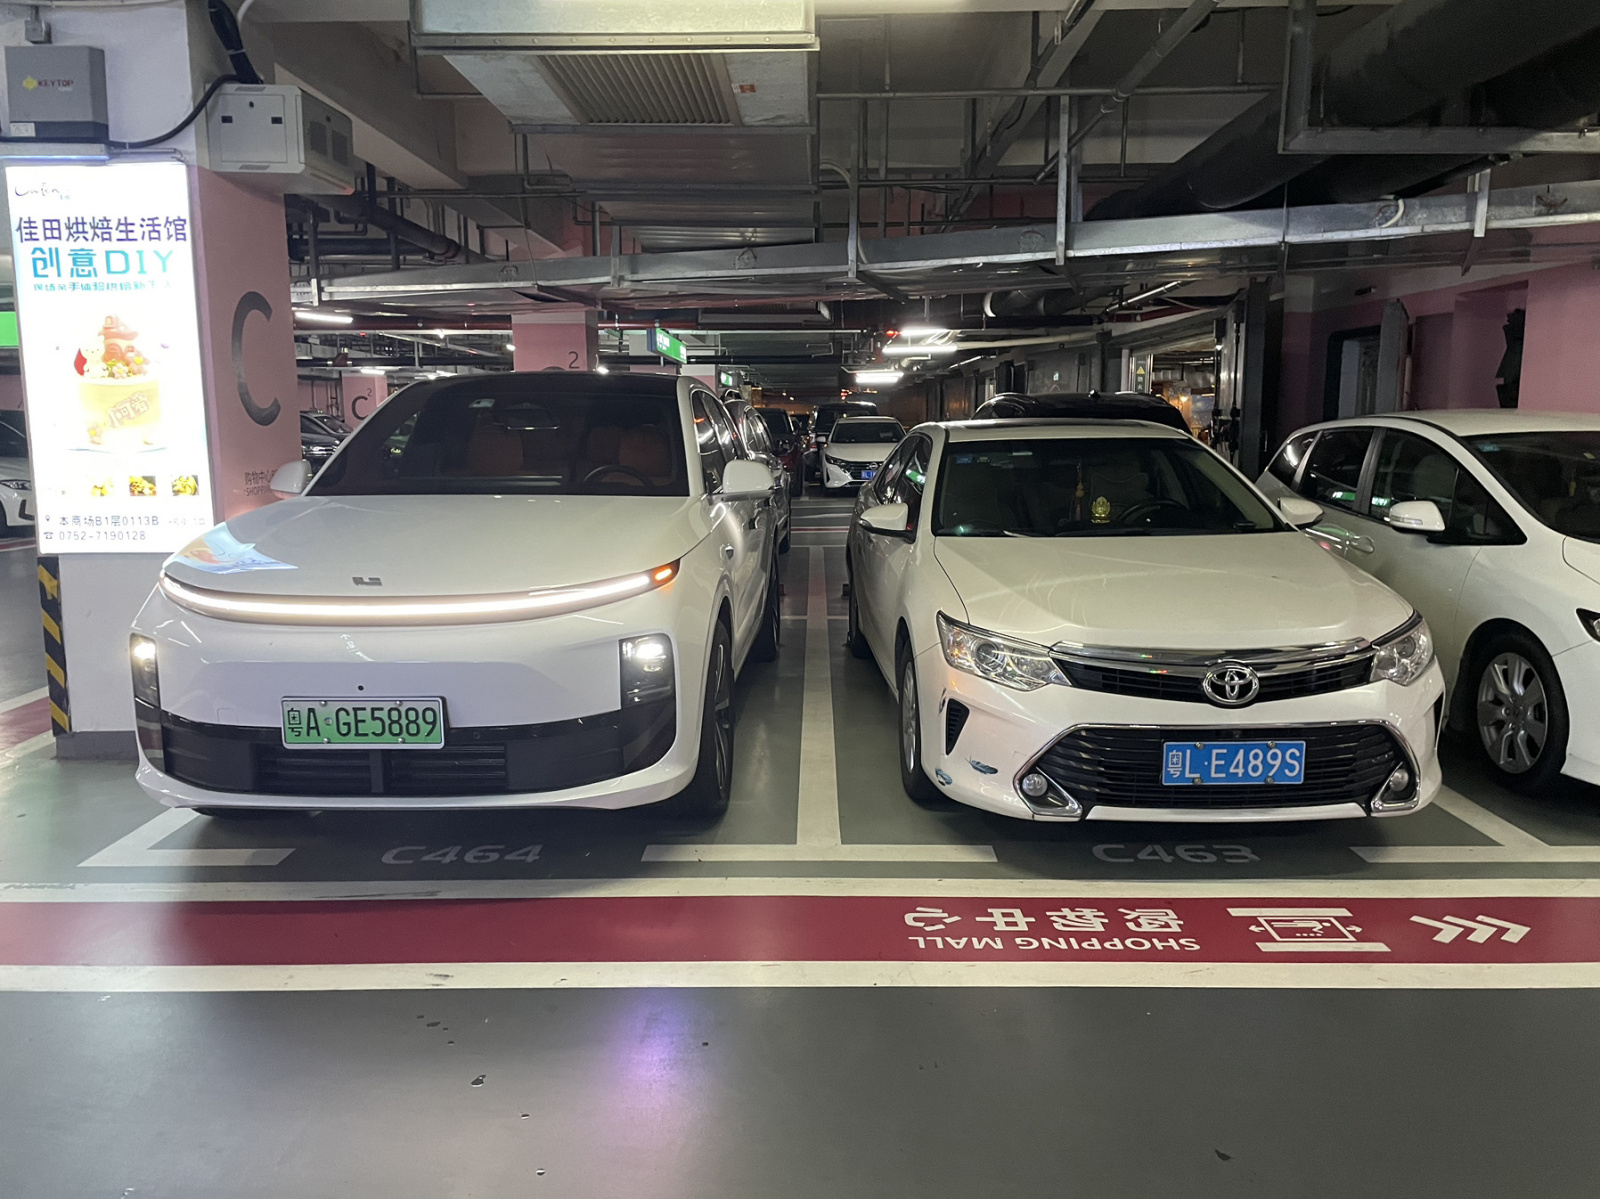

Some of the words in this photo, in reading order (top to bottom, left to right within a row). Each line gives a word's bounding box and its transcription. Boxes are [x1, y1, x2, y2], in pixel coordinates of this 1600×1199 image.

[38, 79, 74, 88] KEYTOP
[15, 216, 188, 243] 佳田烘焙生活馆
[31, 246, 174, 279] 创意DIY
[231, 290, 282, 427] C
[568, 350, 580, 370] 2
[58, 530, 147, 541] 0752-7190128
[381, 844, 544, 865] C464
[1091, 843, 1261, 864] C463
[903, 906, 1185, 933] 购物中心
[907, 936, 1004, 950] MALL
[1014, 937, 1201, 951] SHOPPING
